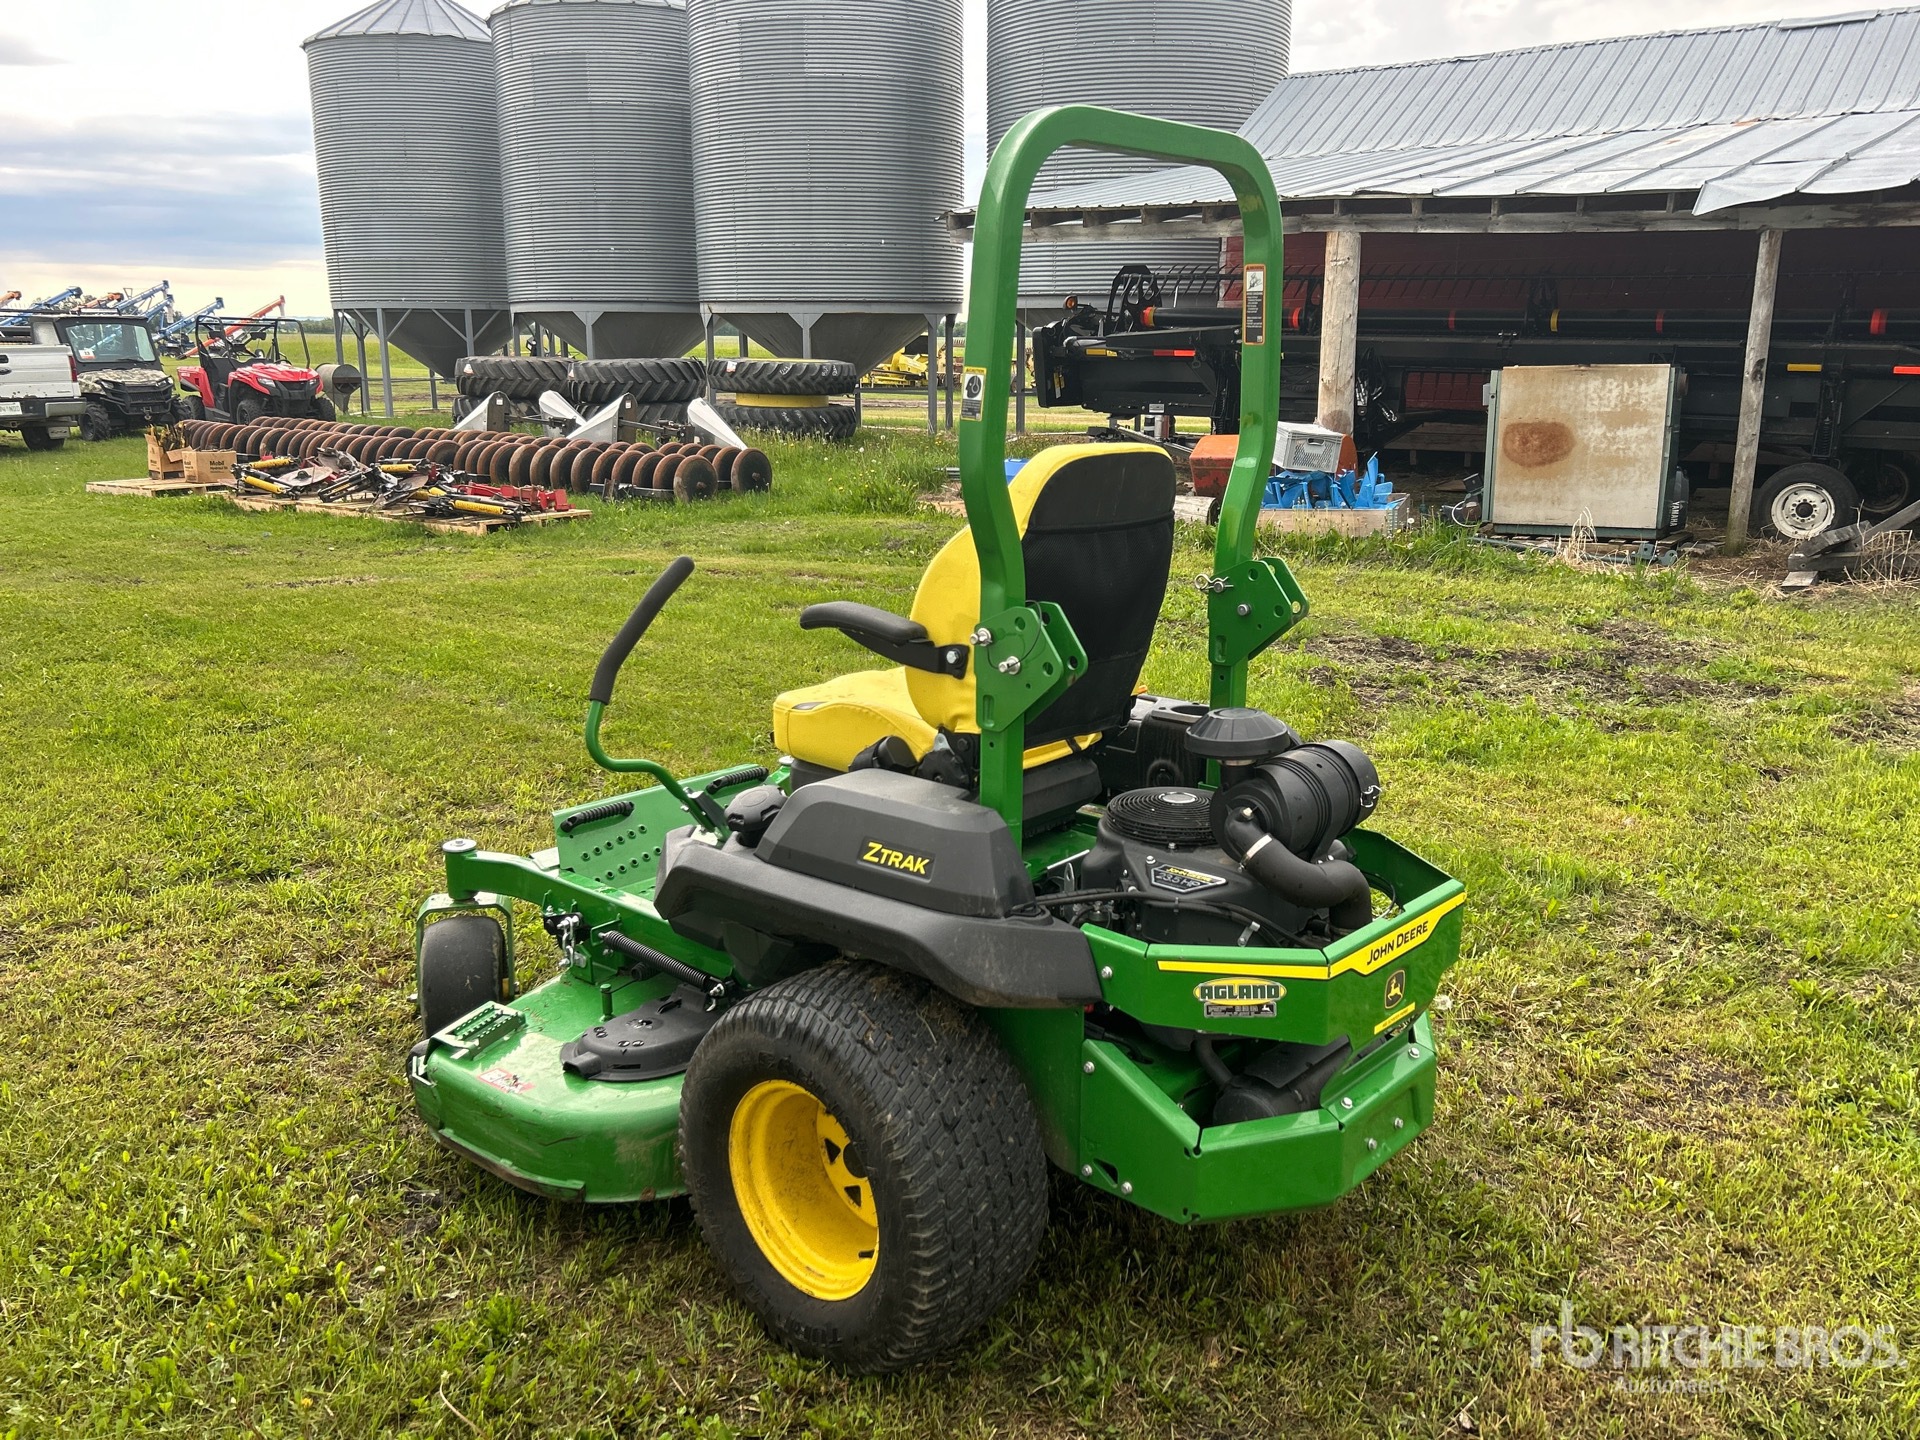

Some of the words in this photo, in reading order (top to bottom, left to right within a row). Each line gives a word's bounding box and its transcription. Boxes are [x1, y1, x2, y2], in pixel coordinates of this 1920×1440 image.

[1670, 501, 1680, 527] YAMAHA
[863, 841, 930, 875] ZTRAK
[1366, 939, 1394, 966] JOHN
[1396, 920, 1429, 949] DEERE
[1200, 984, 1280, 1000] AGLAND
